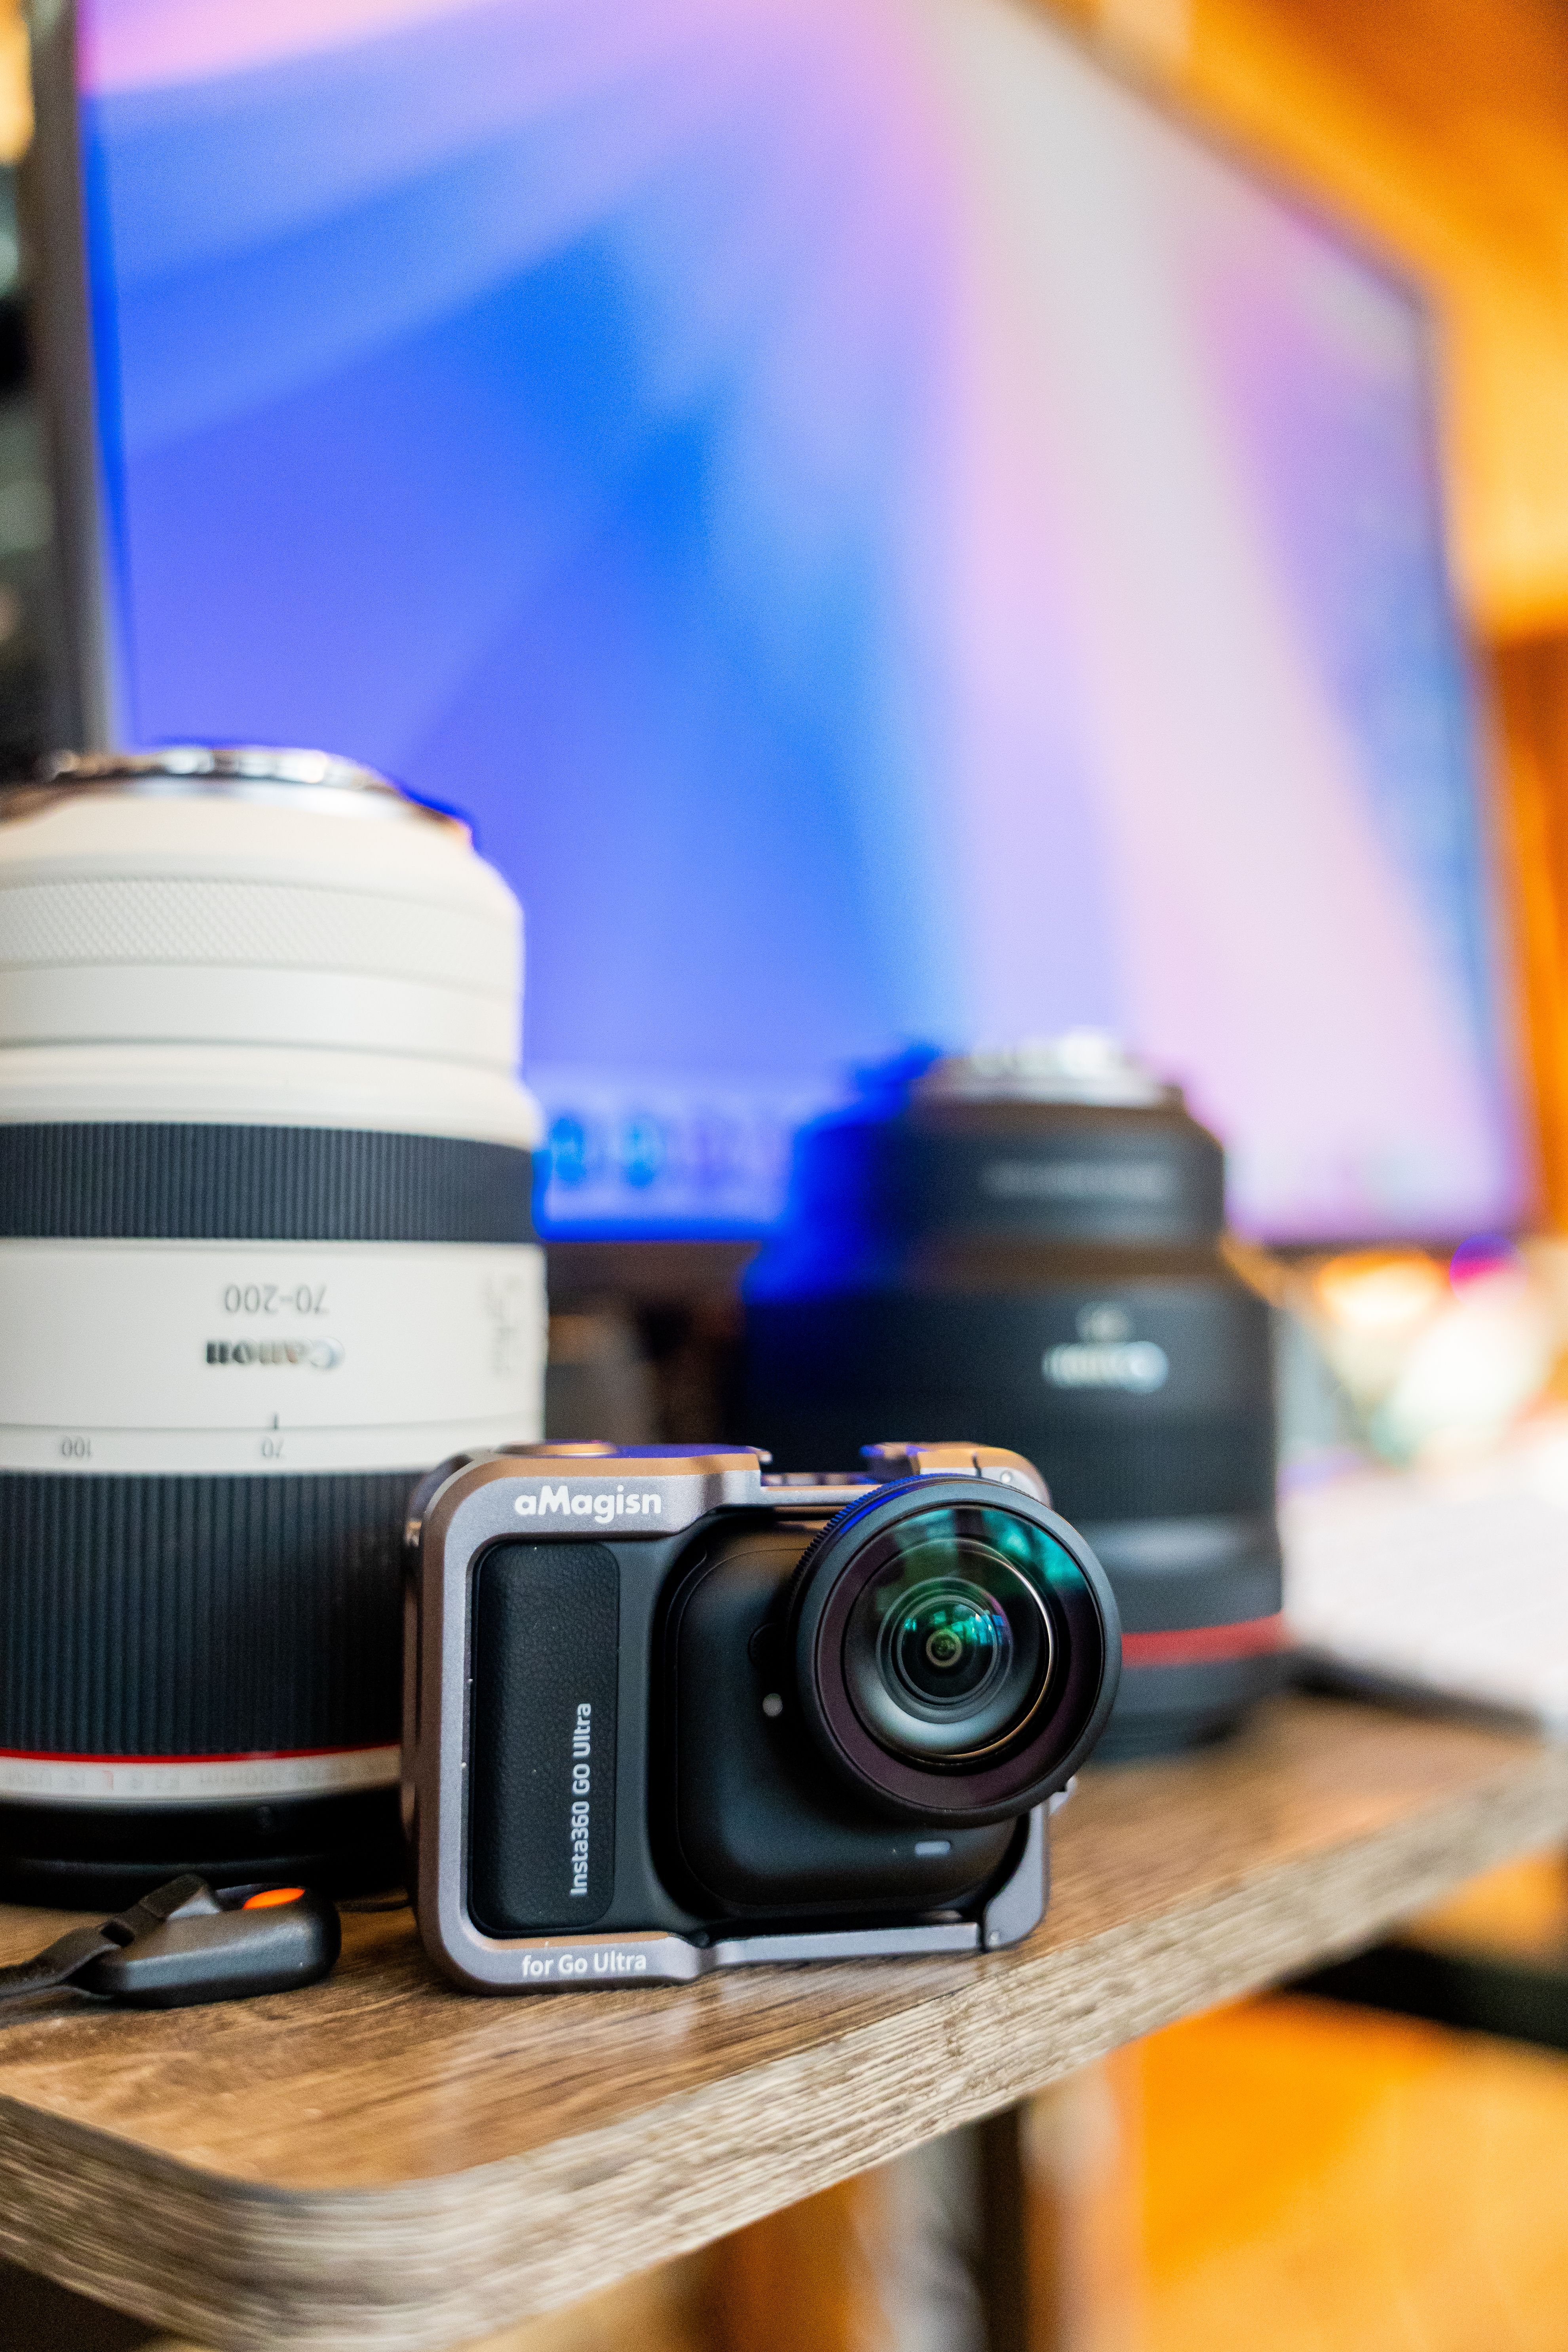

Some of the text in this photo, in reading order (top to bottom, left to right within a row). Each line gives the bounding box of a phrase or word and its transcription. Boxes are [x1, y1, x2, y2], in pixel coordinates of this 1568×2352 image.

[224, 1284, 329, 1314] 70-200
[60, 1436, 93, 1459] 100
[260, 1437, 284, 1459] 70
[514, 1485, 661, 1524] aMagisn
[570, 1702, 591, 1896] Insta360 GO Ultra
[522, 1950, 647, 1977] for Go Ultra
